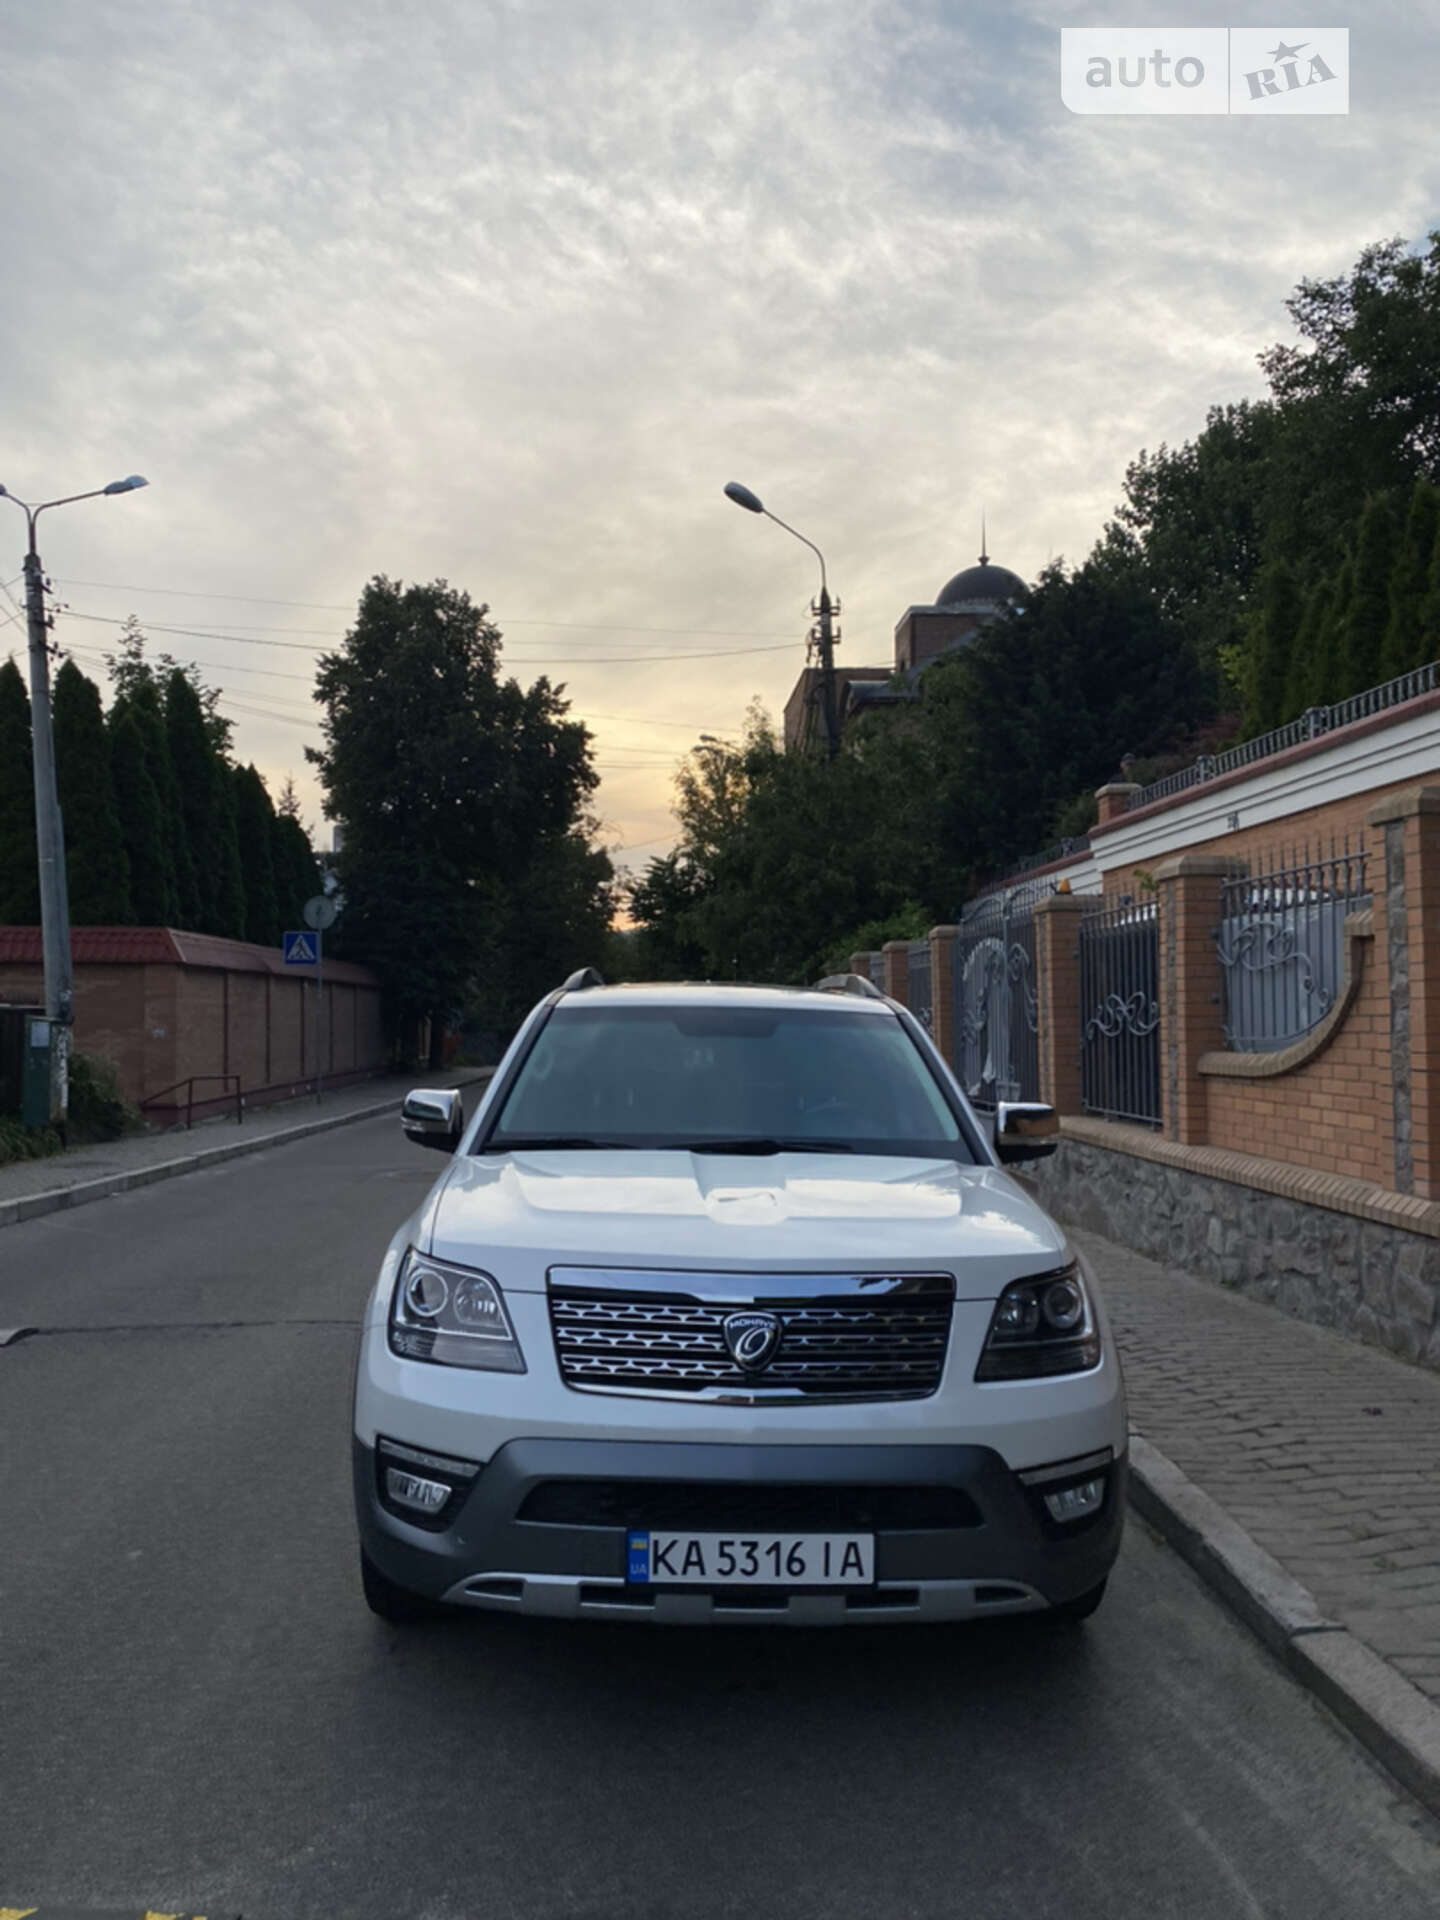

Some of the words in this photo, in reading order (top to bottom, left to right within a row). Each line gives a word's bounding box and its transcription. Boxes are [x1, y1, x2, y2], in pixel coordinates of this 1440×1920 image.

[630, 1564, 647, 1575] UA
[652, 1539, 706, 1576] KA
[717, 1540, 806, 1577] 5316
[824, 1541, 864, 1578] IA
